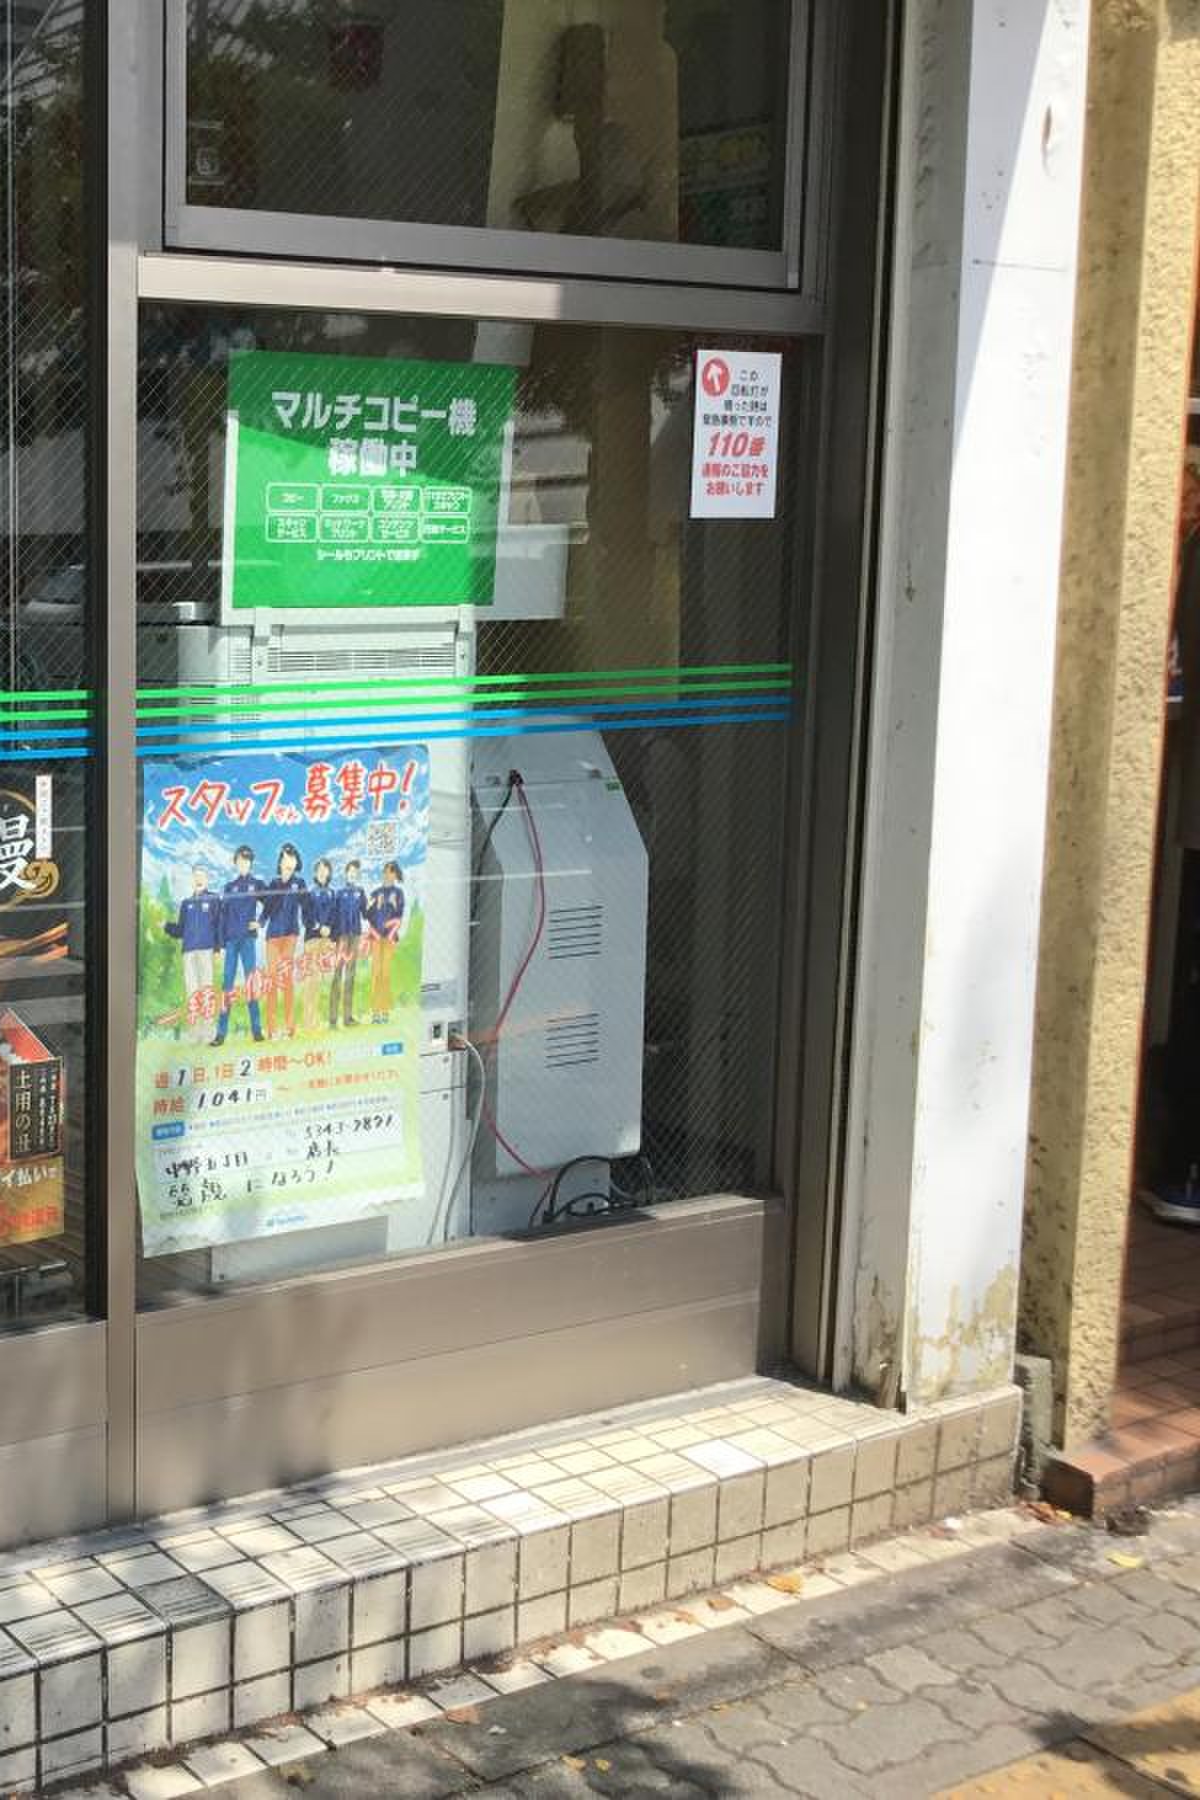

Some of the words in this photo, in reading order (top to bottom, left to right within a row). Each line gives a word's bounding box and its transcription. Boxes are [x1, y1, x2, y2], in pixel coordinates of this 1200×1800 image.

[271, 391, 478, 437] マルチコピー機
[327, 437, 417, 477] 稼働中
[707, 431, 766, 457] 110番
